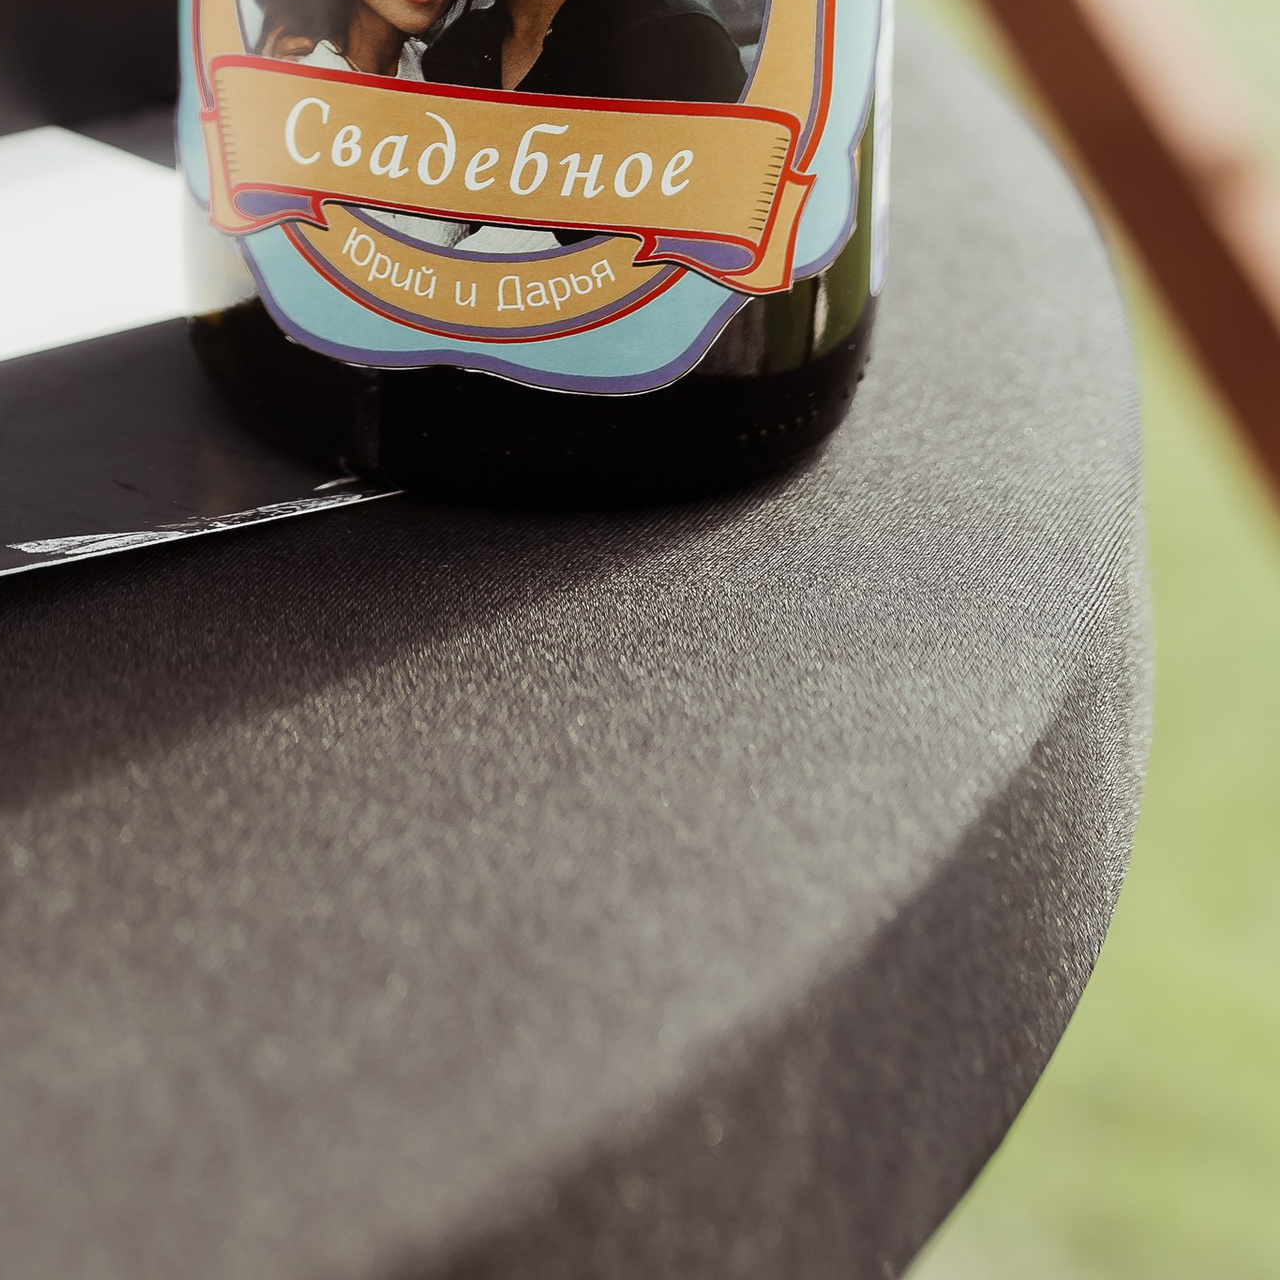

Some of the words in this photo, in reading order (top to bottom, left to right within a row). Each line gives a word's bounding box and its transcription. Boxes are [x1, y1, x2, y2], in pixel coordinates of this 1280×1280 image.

[284, 96, 694, 198] Свадебное
[342, 227, 437, 299] Юрий
[455, 280, 477, 307] и
[497, 259, 616, 311] Дарья
